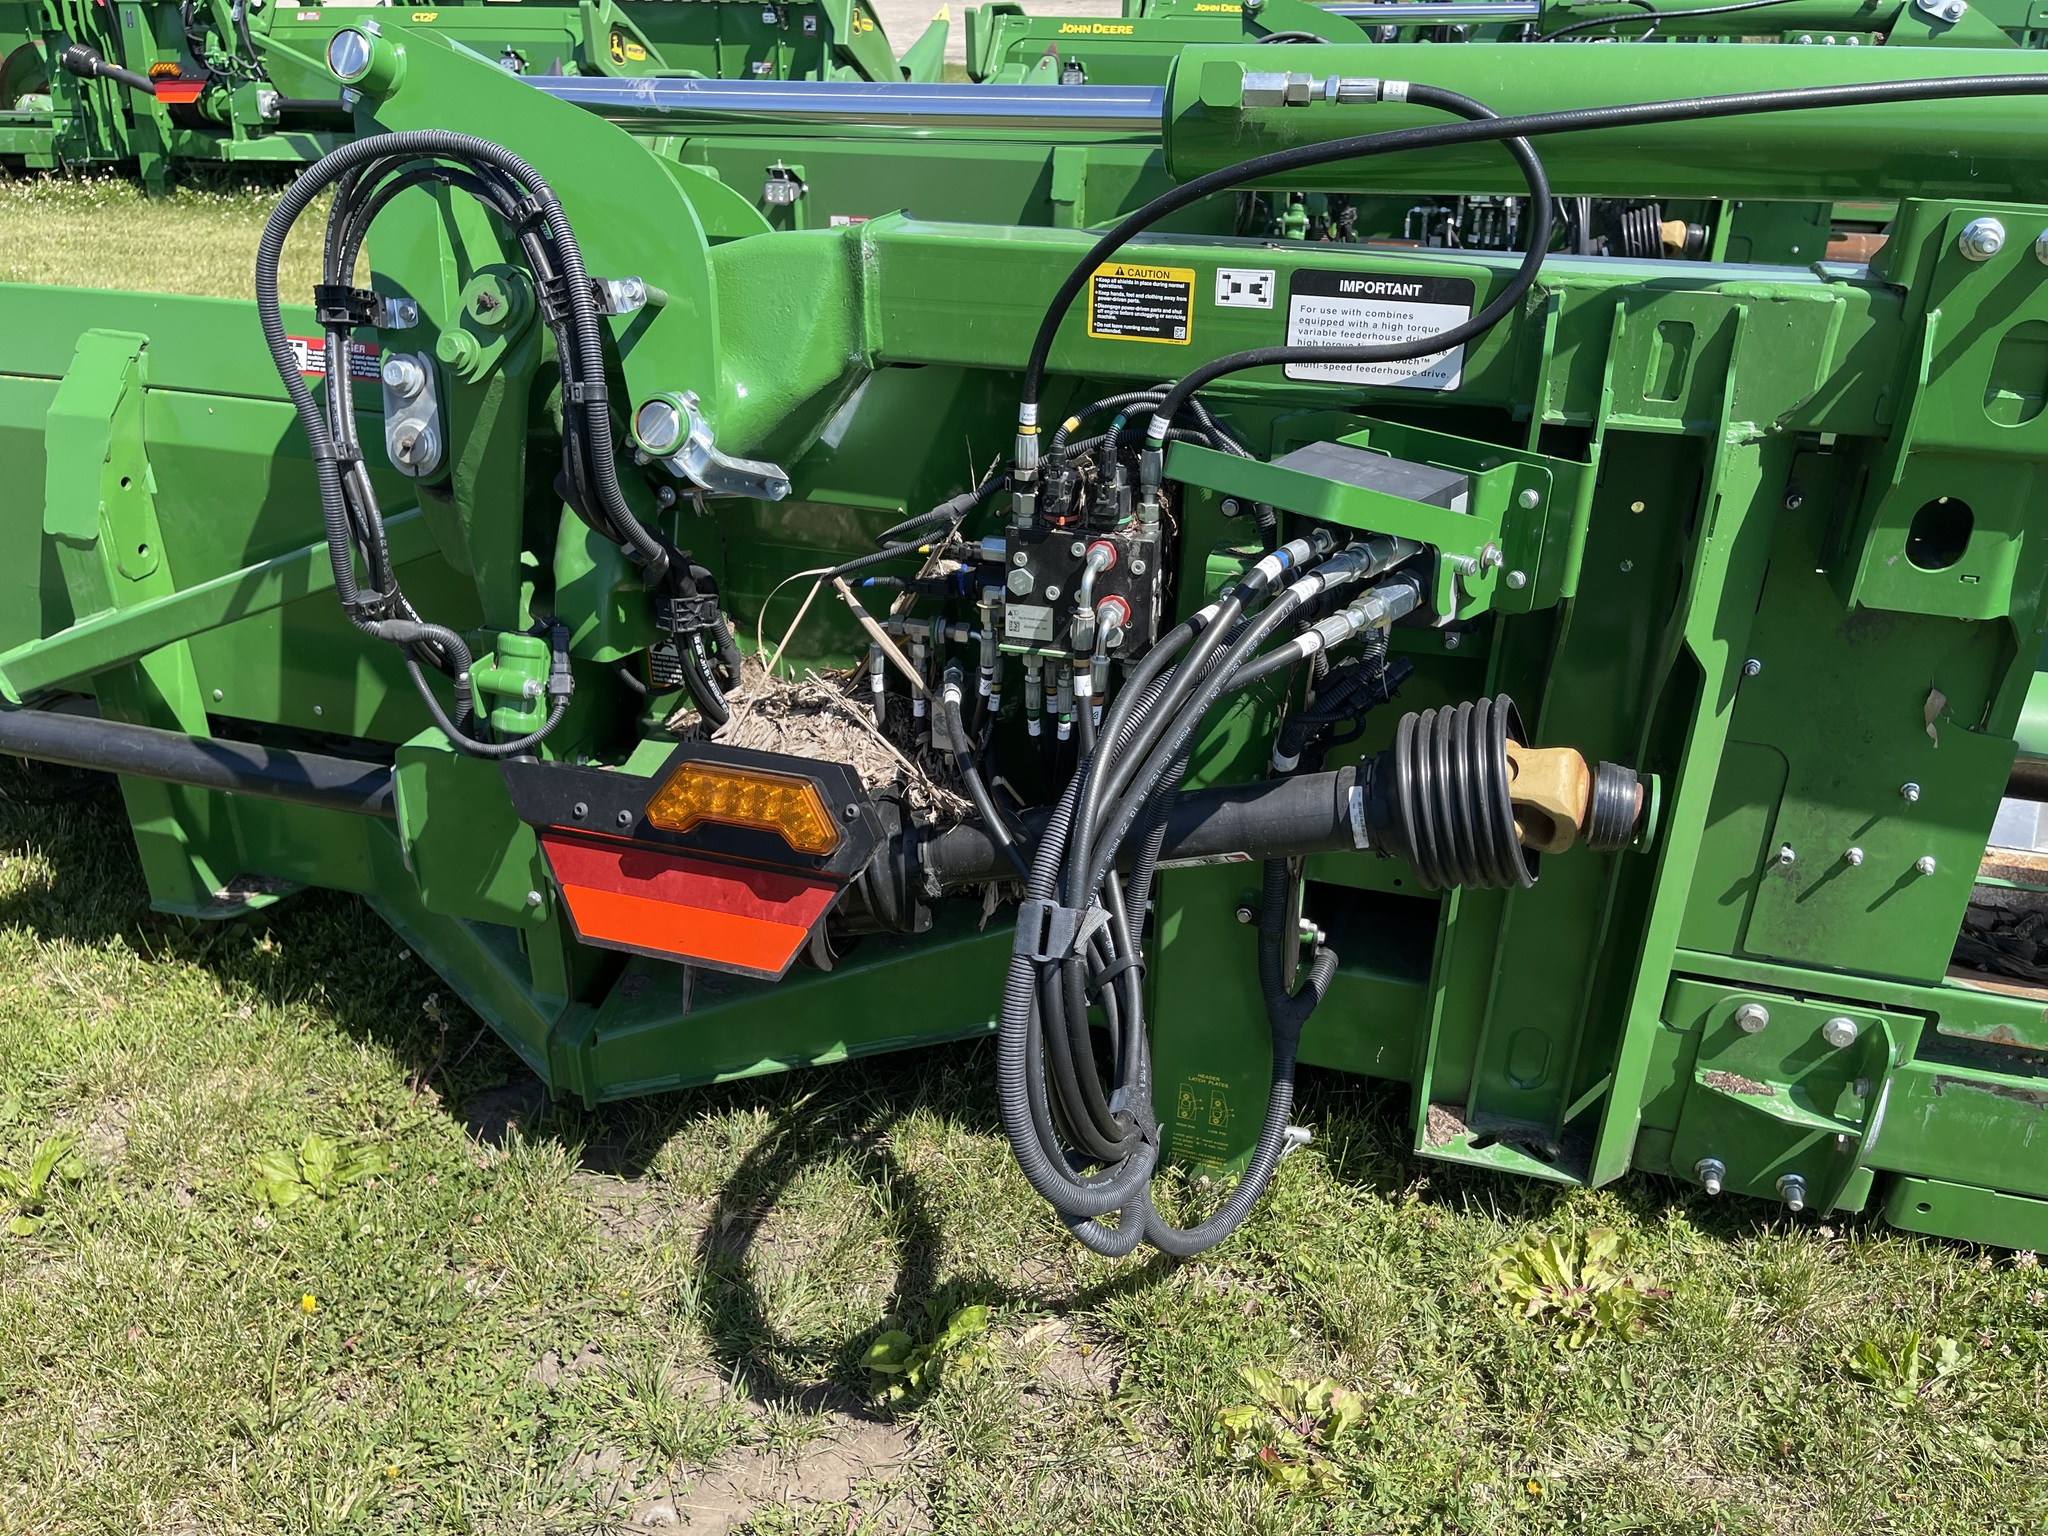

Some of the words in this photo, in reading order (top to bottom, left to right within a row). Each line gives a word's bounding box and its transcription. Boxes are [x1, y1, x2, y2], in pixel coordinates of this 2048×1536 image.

[1194, 3, 1220, 12] JOHN
[412, 13, 438, 22] C12F
[1058, 23, 1091, 34] JOHN
[1092, 23, 1134, 34] DEERE
[1128, 268, 1170, 279] CAUTION
[1339, 280, 1422, 296] IMPORTANT
[1300, 305, 1317, 313] For
[1341, 308, 1361, 317] with
[1365, 310, 1414, 320] combines
[1299, 317, 1345, 328] equipped
[1348, 319, 1369, 328] with
[1382, 321, 1404, 332] high
[1407, 323, 1440, 334] torque
[1298, 328, 1337, 337] variable
[1340, 330, 1402, 342] feederhouse
[1355, 365, 1418, 377] feederhouse
[1421, 370, 1449, 379] drive.
[1260, 626, 1271, 639] EN
[1210, 687, 1221, 699] DN
[1105, 838, 1120, 862] MADE
[1098, 868, 1108, 881] IN
[1208, 1080, 1228, 1088] PLATES
